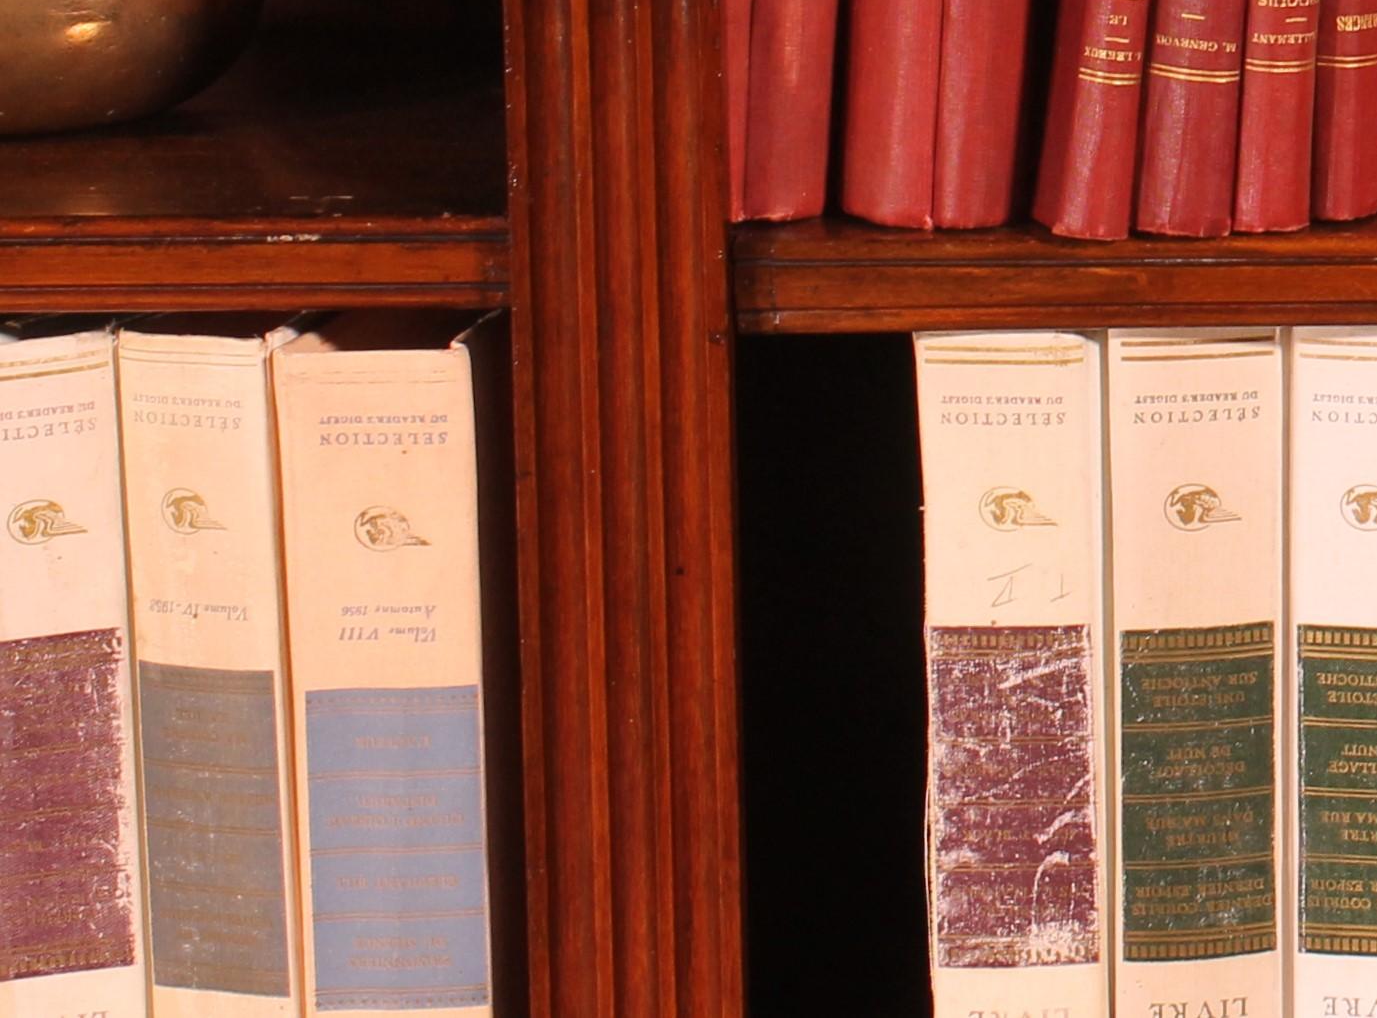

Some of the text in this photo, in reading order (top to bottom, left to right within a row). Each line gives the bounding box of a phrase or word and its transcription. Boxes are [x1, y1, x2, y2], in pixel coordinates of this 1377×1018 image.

[985, 395, 1042, 405] READER'S
[1044, 395, 1064, 406] DU
[1133, 390, 1259, 405] DU READER'S DIGEST
[133, 410, 242, 432] SÉLECTION
[940, 410, 1067, 430] SÉLECTION
[1132, 405, 1261, 426] SÉLECTION
[203, 604, 248, 622] Volume
[337, 626, 437, 642] Volume VIII
[1148, 996, 1249, 1018] LIVRE
